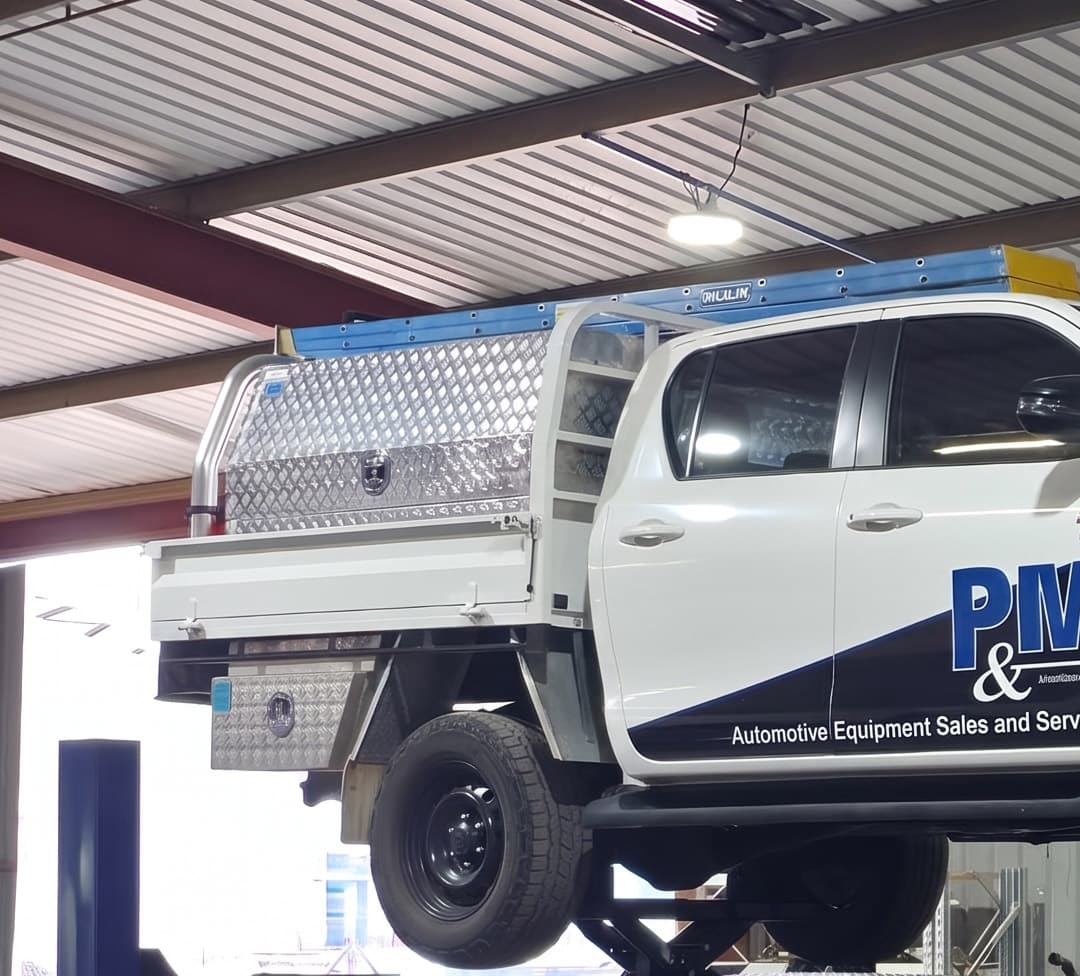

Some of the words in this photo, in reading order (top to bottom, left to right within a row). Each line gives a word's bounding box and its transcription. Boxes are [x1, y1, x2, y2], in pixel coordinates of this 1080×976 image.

[732, 723, 828, 745] Automotive
[834, 717, 932, 744] Equipment
[936, 714, 989, 736] Sales
[994, 712, 1030, 733] and
